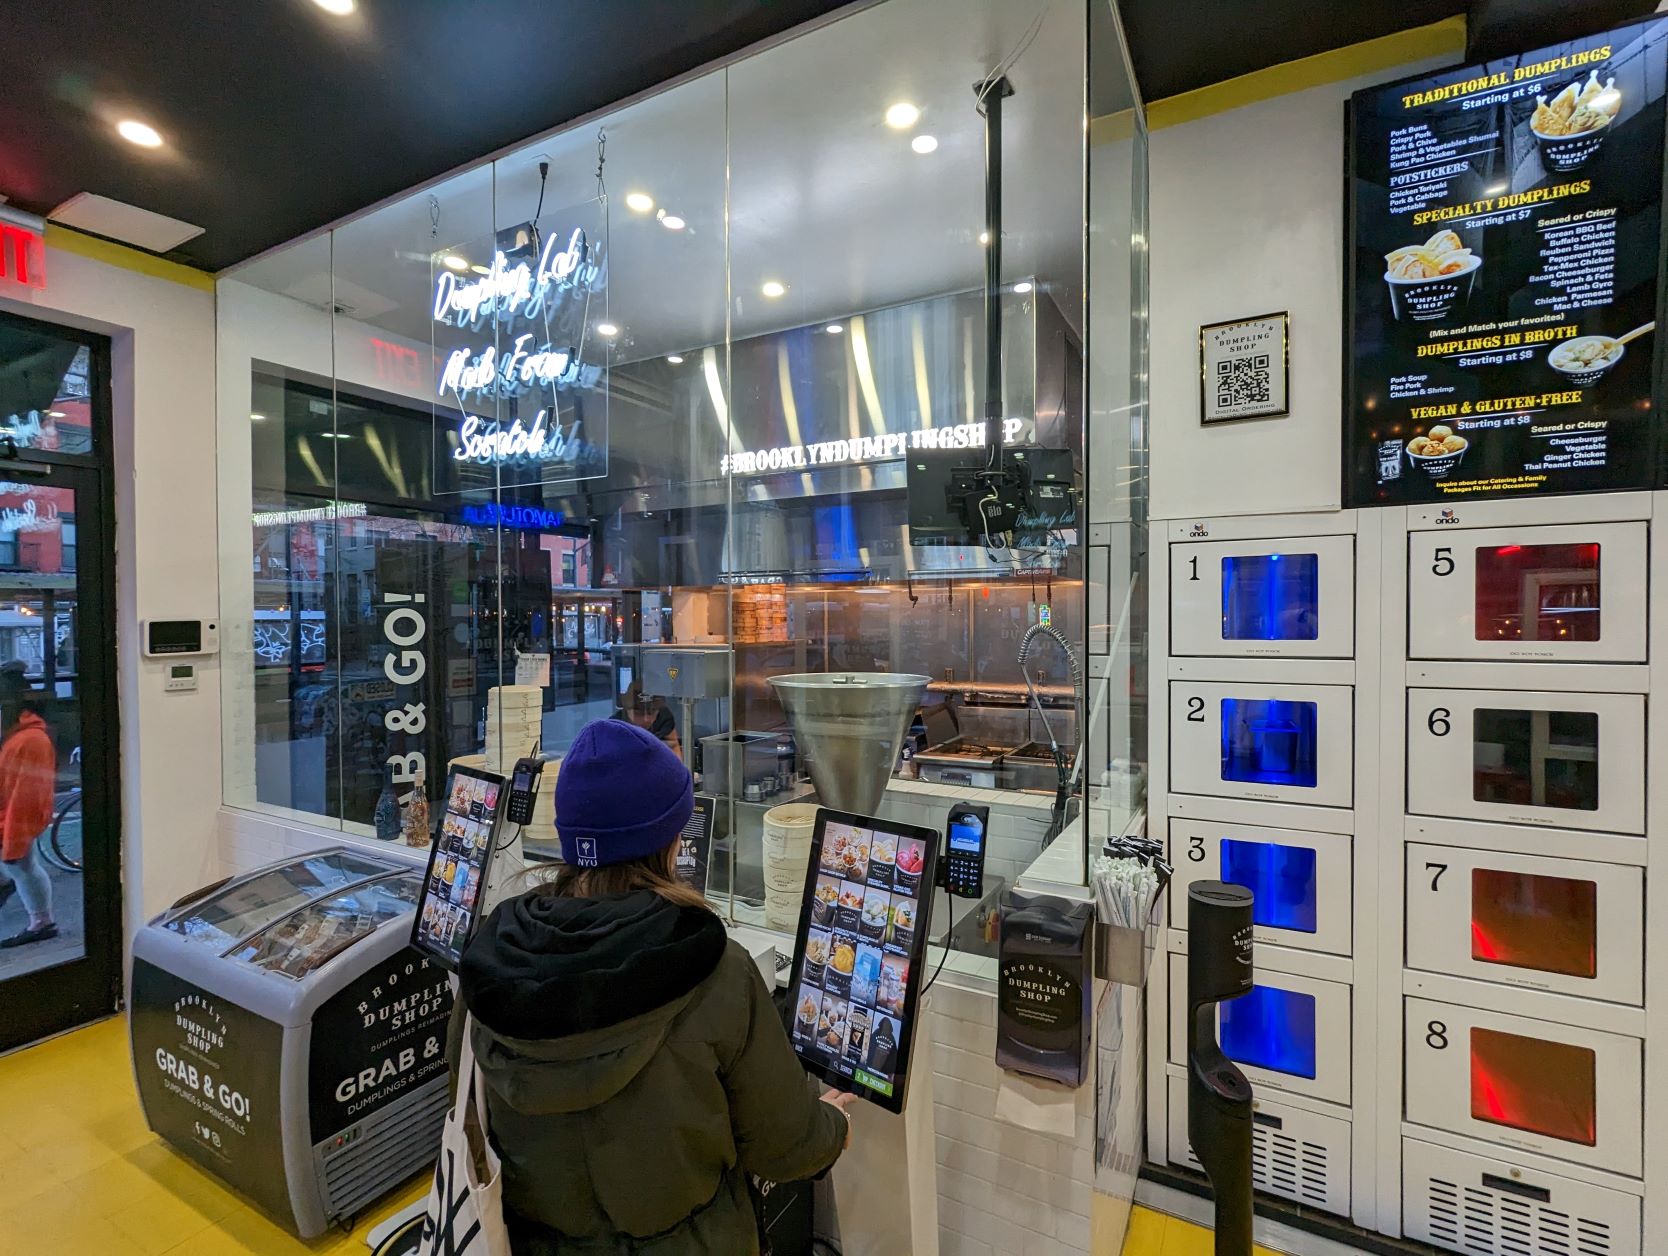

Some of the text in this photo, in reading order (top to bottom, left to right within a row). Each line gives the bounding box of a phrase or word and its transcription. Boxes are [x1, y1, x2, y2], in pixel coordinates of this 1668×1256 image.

[1402, 46, 1612, 108] TRADITIONAL DUMPLINGS
[1462, 83, 1541, 110] Starting at $6
[1390, 131, 1431, 145] Crispy Pork
[1391, 125, 1427, 137] Pork Buns
[1390, 145, 1407, 153] Pork
[1416, 138, 1437, 147] Chive
[1390, 150, 1417, 161] Shrimp
[1426, 139, 1467, 153] Vegetables
[1390, 160, 1409, 169] Kung
[1426, 150, 1456, 160] Chicken
[1390, 161, 1469, 186] POTSTICKERS
[1390, 181, 1447, 199] Chicken Teriyaki
[1390, 198, 1406, 206] Pork
[1415, 190, 1448, 201] Cabbage
[1390, 202, 1426, 214] Vegetable
[1413, 180, 1591, 225] SPECIALTY DUMPLINGS
[1465, 209, 1531, 229] Starting at $7
[1538, 215, 1571, 227] Seared
[1585, 208, 1617, 219] Crispy
[1544, 221, 1616, 240] Korean BBQ Beef
[1550, 231, 1615, 247] Buffalo Chicken
[538, 227, 583, 285] Lab
[1540, 239, 1615, 256] Reuben Sandwich
[1549, 247, 1615, 264] Pepperoni Pizza
[1529, 264, 1614, 283] Bacon Cheeseburger
[1543, 256, 1615, 272] Tex-Mex Chicken
[1550, 277, 1584, 288] Spinach
[1595, 272, 1614, 281] Feta
[1567, 281, 1613, 293] Lamb Gyro
[1535, 289, 1613, 305] Chicken Parmesan
[1553, 301, 1571, 311] Mac
[1581, 298, 1613, 307] Cheese
[1215, 323, 1274, 340] BROOKLYN
[1429, 312, 1565, 339] (Mix and Match your favorites)
[1219, 333, 1270, 346] DUMPLING
[1229, 343, 1256, 352] SHOP
[1417, 325, 1578, 357] DUMPLINGS IN BROTH
[1459, 350, 1534, 367] Starting at $8
[1390, 390, 1418, 398] Chicken
[1410, 403, 1457, 419] VEGAN
[1461, 401, 1472, 414] &
[1457, 415, 1531, 430] Starting at $8
[1531, 423, 1563, 433] Seared
[1577, 420, 1608, 429] Crispy
[720, 418, 1023, 475] #BROOKLYNDUMPLINGSHP
[1550, 436, 1607, 446] Cheeseburger
[1565, 443, 1606, 452] Vegetable
[1543, 461, 1571, 469] Peanut
[1573, 459, 1606, 467] Chicken
[1573, 451, 1606, 459] Chicken
[1435, 516, 1460, 525] ondo
[1189, 556, 1200, 580] 1
[1431, 547, 1455, 577] 5
[384, 591, 426, 734] & GO!
[1187, 697, 1205, 722] 2
[1427, 707, 1451, 736] 6
[1187, 836, 1206, 862] 3
[578, 859, 598, 867] NYU
[1425, 862, 1448, 892] 7
[1004, 964, 1071, 988] BROOKLYN
[356, 957, 430, 1015] BROOK
[1009, 977, 1066, 996] DUMPLING
[363, 979, 452, 1028] DUMPLIN
[1020, 990, 1051, 1003] SHOP
[174, 995, 227, 1036] BROOKLYN
[391, 997, 442, 1031] SHOP
[176, 1014, 224, 1048] DUMPLING
[370, 1026, 416, 1053] DUMPLINGS
[1425, 1020, 1449, 1050] 8
[187, 1032, 212, 1054] SHOP
[335, 1036, 440, 1103] GRAB &
[156, 1047, 200, 1090] GRAB
[203, 1074, 215, 1100] &
[218, 1084, 250, 1122] GO!
[347, 1077, 407, 1116] DUMPLINGS
[408, 1073, 416, 1083] &
